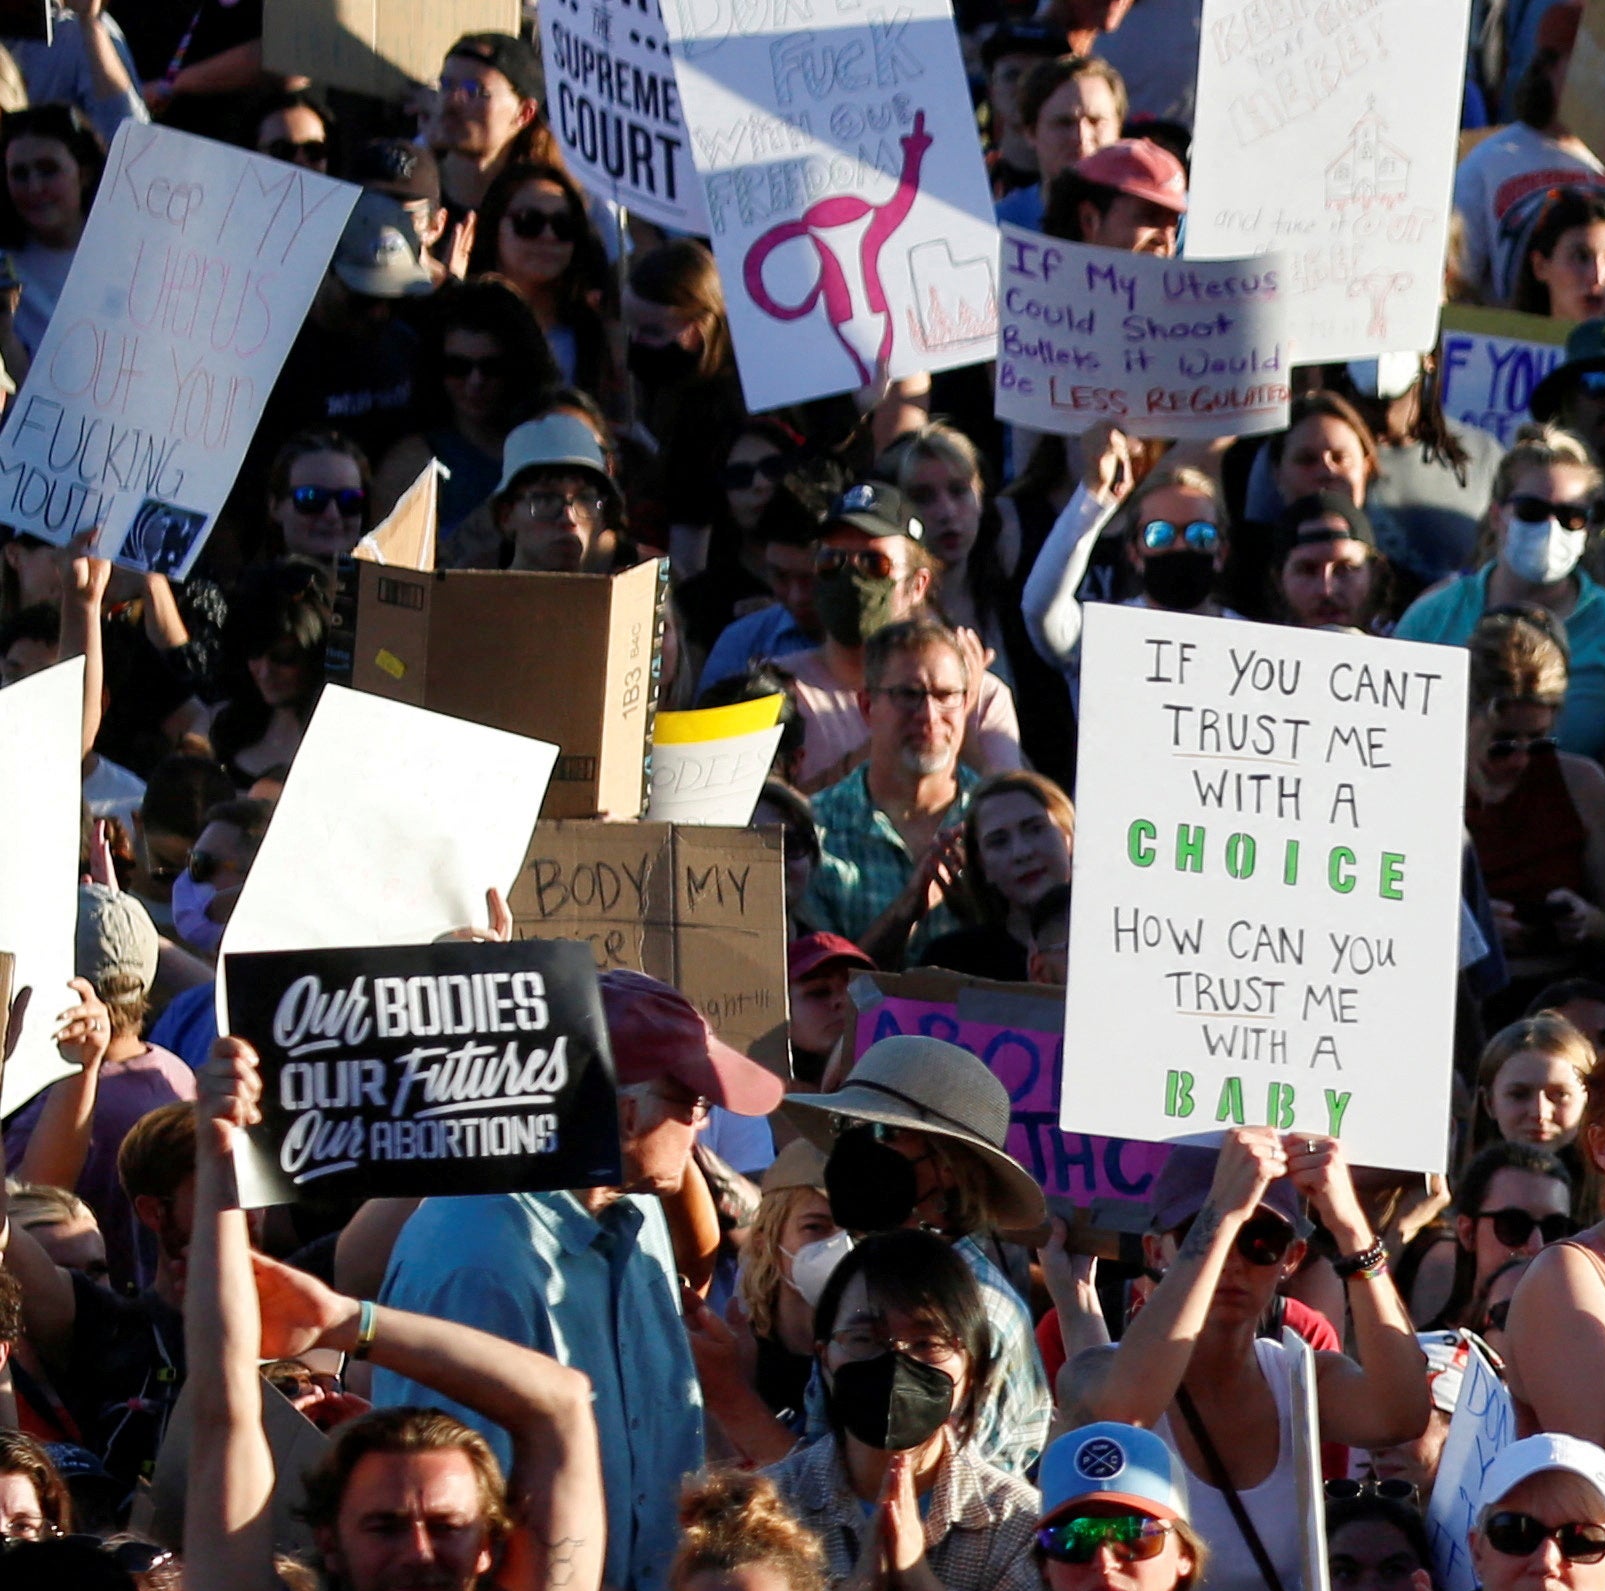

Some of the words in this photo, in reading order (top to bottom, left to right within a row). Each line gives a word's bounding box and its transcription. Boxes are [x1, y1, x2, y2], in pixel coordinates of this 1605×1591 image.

[552, 21, 680, 127] SUPREME
[558, 81, 681, 200] COURT
[217, 159, 344, 264] MY
[707, 138, 902, 235] FREEDOM
[1005, 236, 1063, 282] If
[1086, 261, 1137, 300] My
[1163, 270, 1279, 302] Uterus
[1006, 288, 1096, 336] Could
[1122, 316, 1235, 344] Shoot
[1002, 328, 1100, 371] Bullets
[1124, 347, 1151, 372] it
[1179, 345, 1280, 379] Would
[1001, 363, 1033, 393] Be
[1049, 376, 1130, 415] LESS
[1146, 384, 1291, 413] REGULATED
[12, 395, 183, 498] FUCKING
[1145, 638, 1198, 686] IF
[1228, 648, 1302, 696] YOU
[1330, 662, 1443, 716] CANT
[1162, 703, 1310, 760] TRUST
[1326, 728, 1391, 769] ME
[1192, 770, 1303, 821] WITH
[1329, 783, 1359, 829] A
[531, 857, 652, 917] BODY
[686, 863, 750, 915] MY
[1127, 819, 1407, 900] CHOICE
[1112, 906, 1202, 956] HOW
[1228, 920, 1305, 968] CAN
[1330, 931, 1398, 976] YOU
[273, 975, 370, 1050] Our
[376, 972, 549, 1038] BODIES
[1164, 971, 1286, 1014] TRUST
[1301, 986, 1360, 1026] ME
[279, 1059, 384, 1110] OUR
[391, 1036, 568, 1113] Futures
[1201, 1023, 1288, 1066] WITH
[1309, 1034, 1343, 1071] A
[1164, 1068, 1354, 1138] BABY
[279, 1112, 365, 1173] Our
[369, 1113, 558, 1163] ABORTIONS
